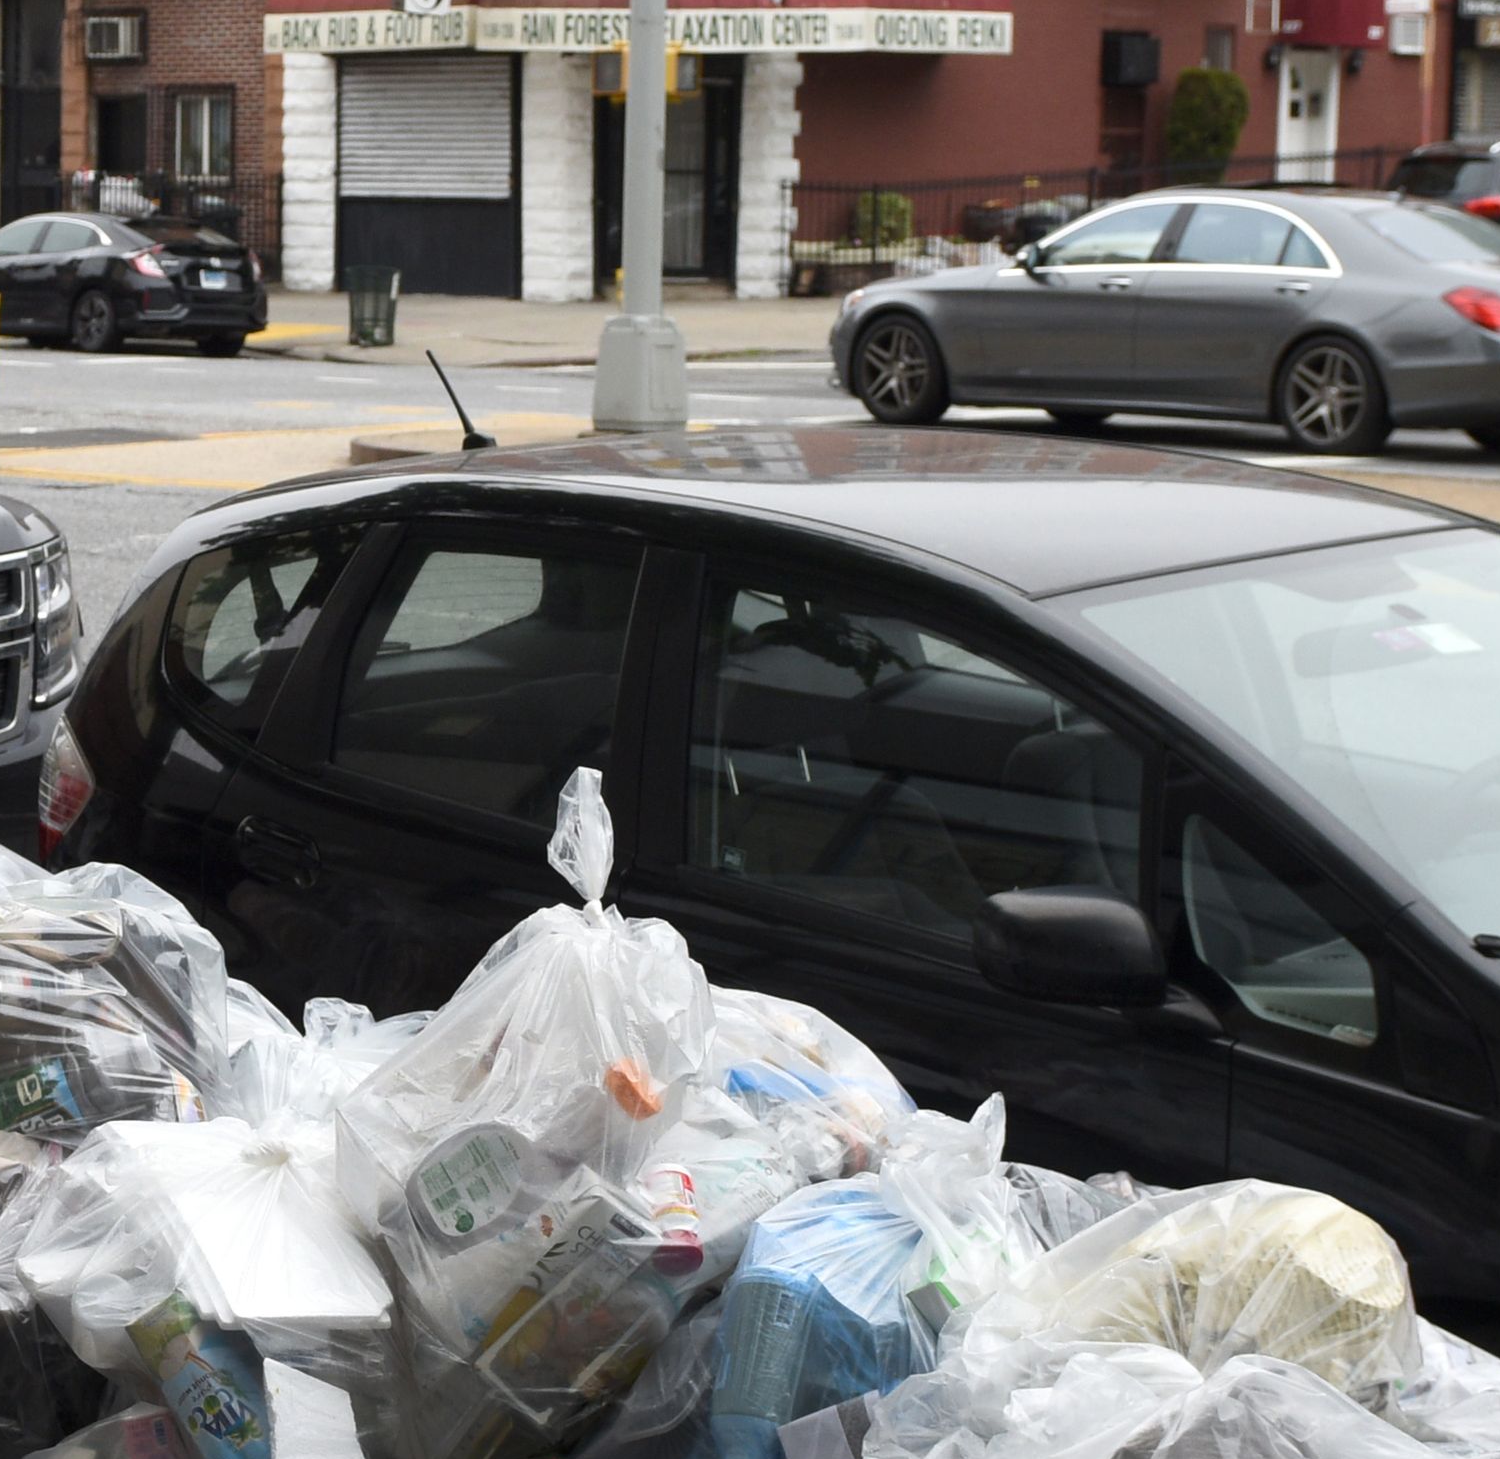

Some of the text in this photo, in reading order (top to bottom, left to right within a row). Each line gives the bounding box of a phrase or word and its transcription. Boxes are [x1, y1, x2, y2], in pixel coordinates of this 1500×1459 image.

[281, 19, 321, 48] BACK
[328, 16, 359, 46] RUB
[365, 15, 376, 45] &
[385, 12, 423, 44] FOOT
[431, 11, 464, 43] RUB
[520, 13, 557, 44] RAIN
[563, 13, 632, 45] FOREST
[771, 13, 829, 45] CENTER
[874, 14, 948, 47] QIGONG
[957, 17, 1006, 48] REIKI
[204, 1398, 257, 1441] VITA
